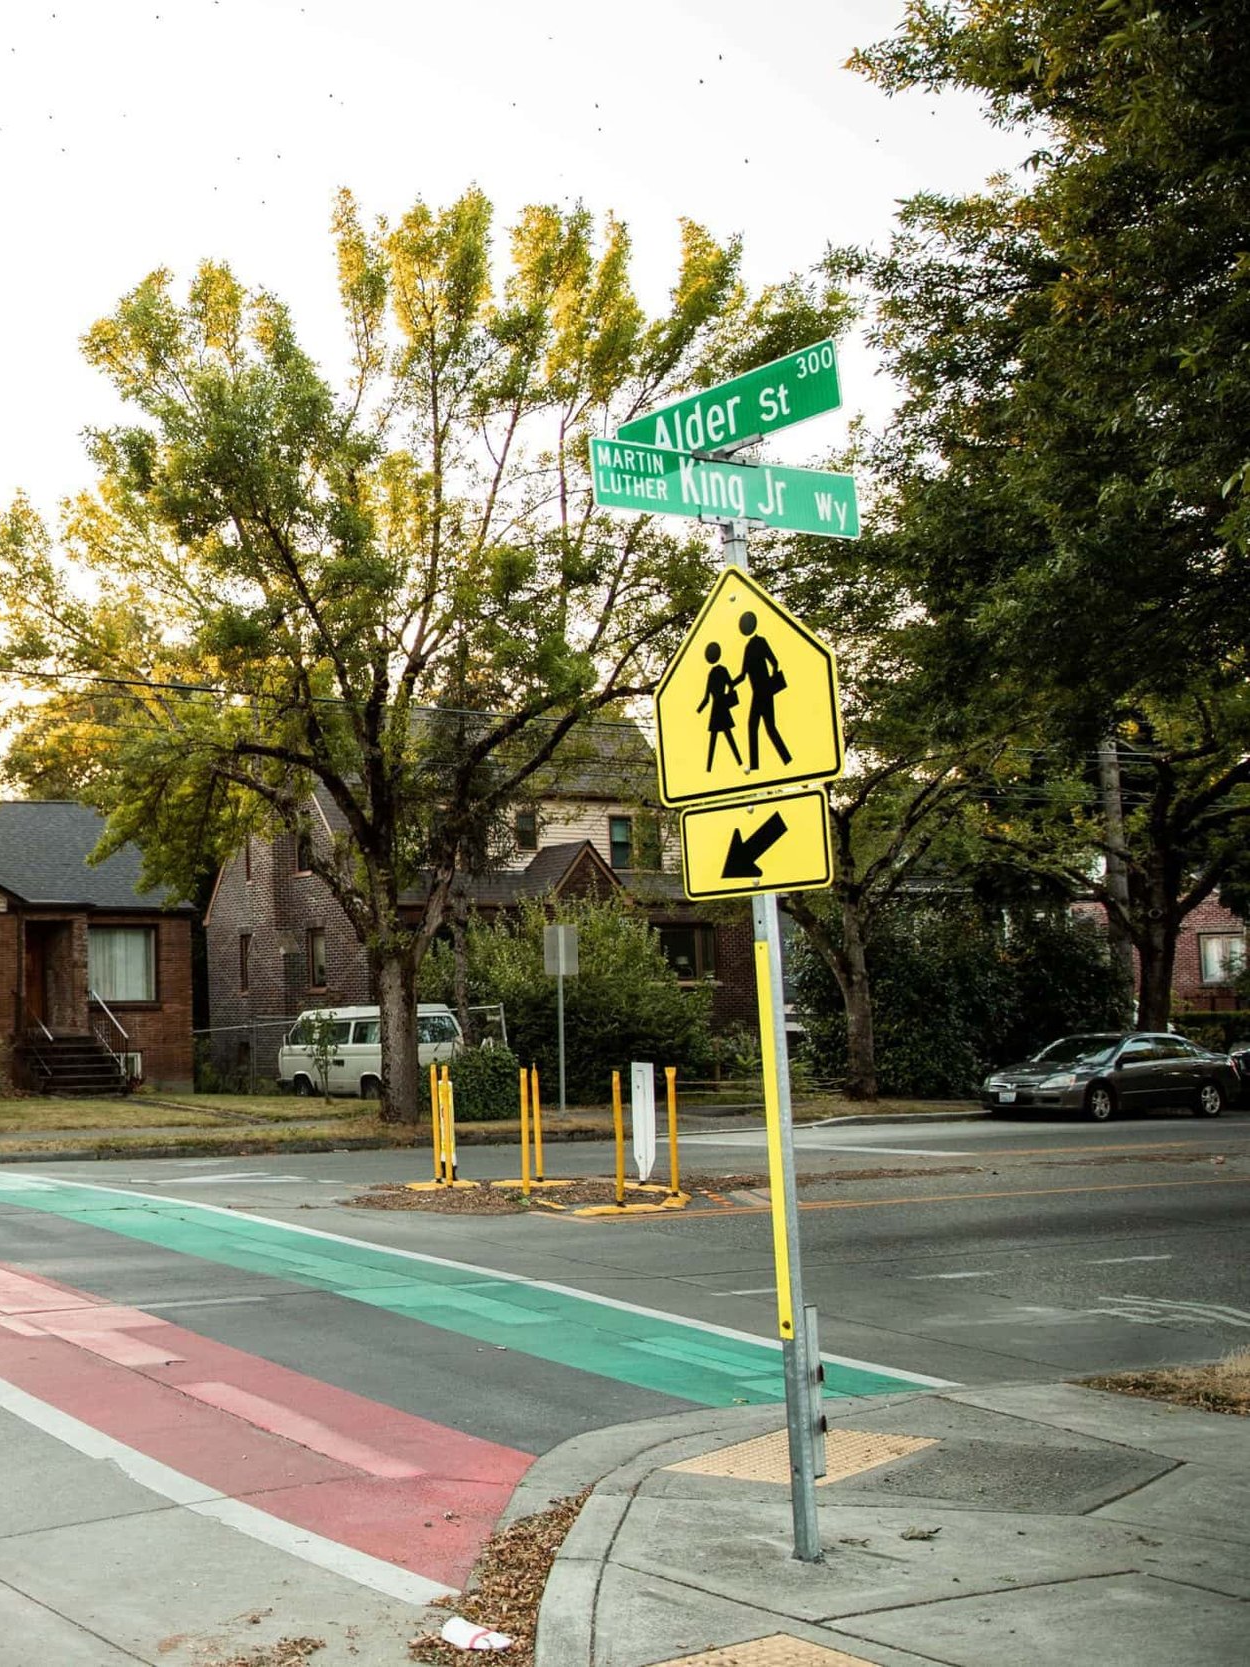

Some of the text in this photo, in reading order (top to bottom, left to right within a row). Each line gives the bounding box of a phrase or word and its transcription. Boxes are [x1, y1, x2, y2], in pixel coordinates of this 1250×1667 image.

[654, 346, 833, 453] Alder St 300
[597, 444, 664, 474] MARTIN
[600, 473, 668, 501] LUTHER
[679, 456, 847, 531] King Jr Wy
